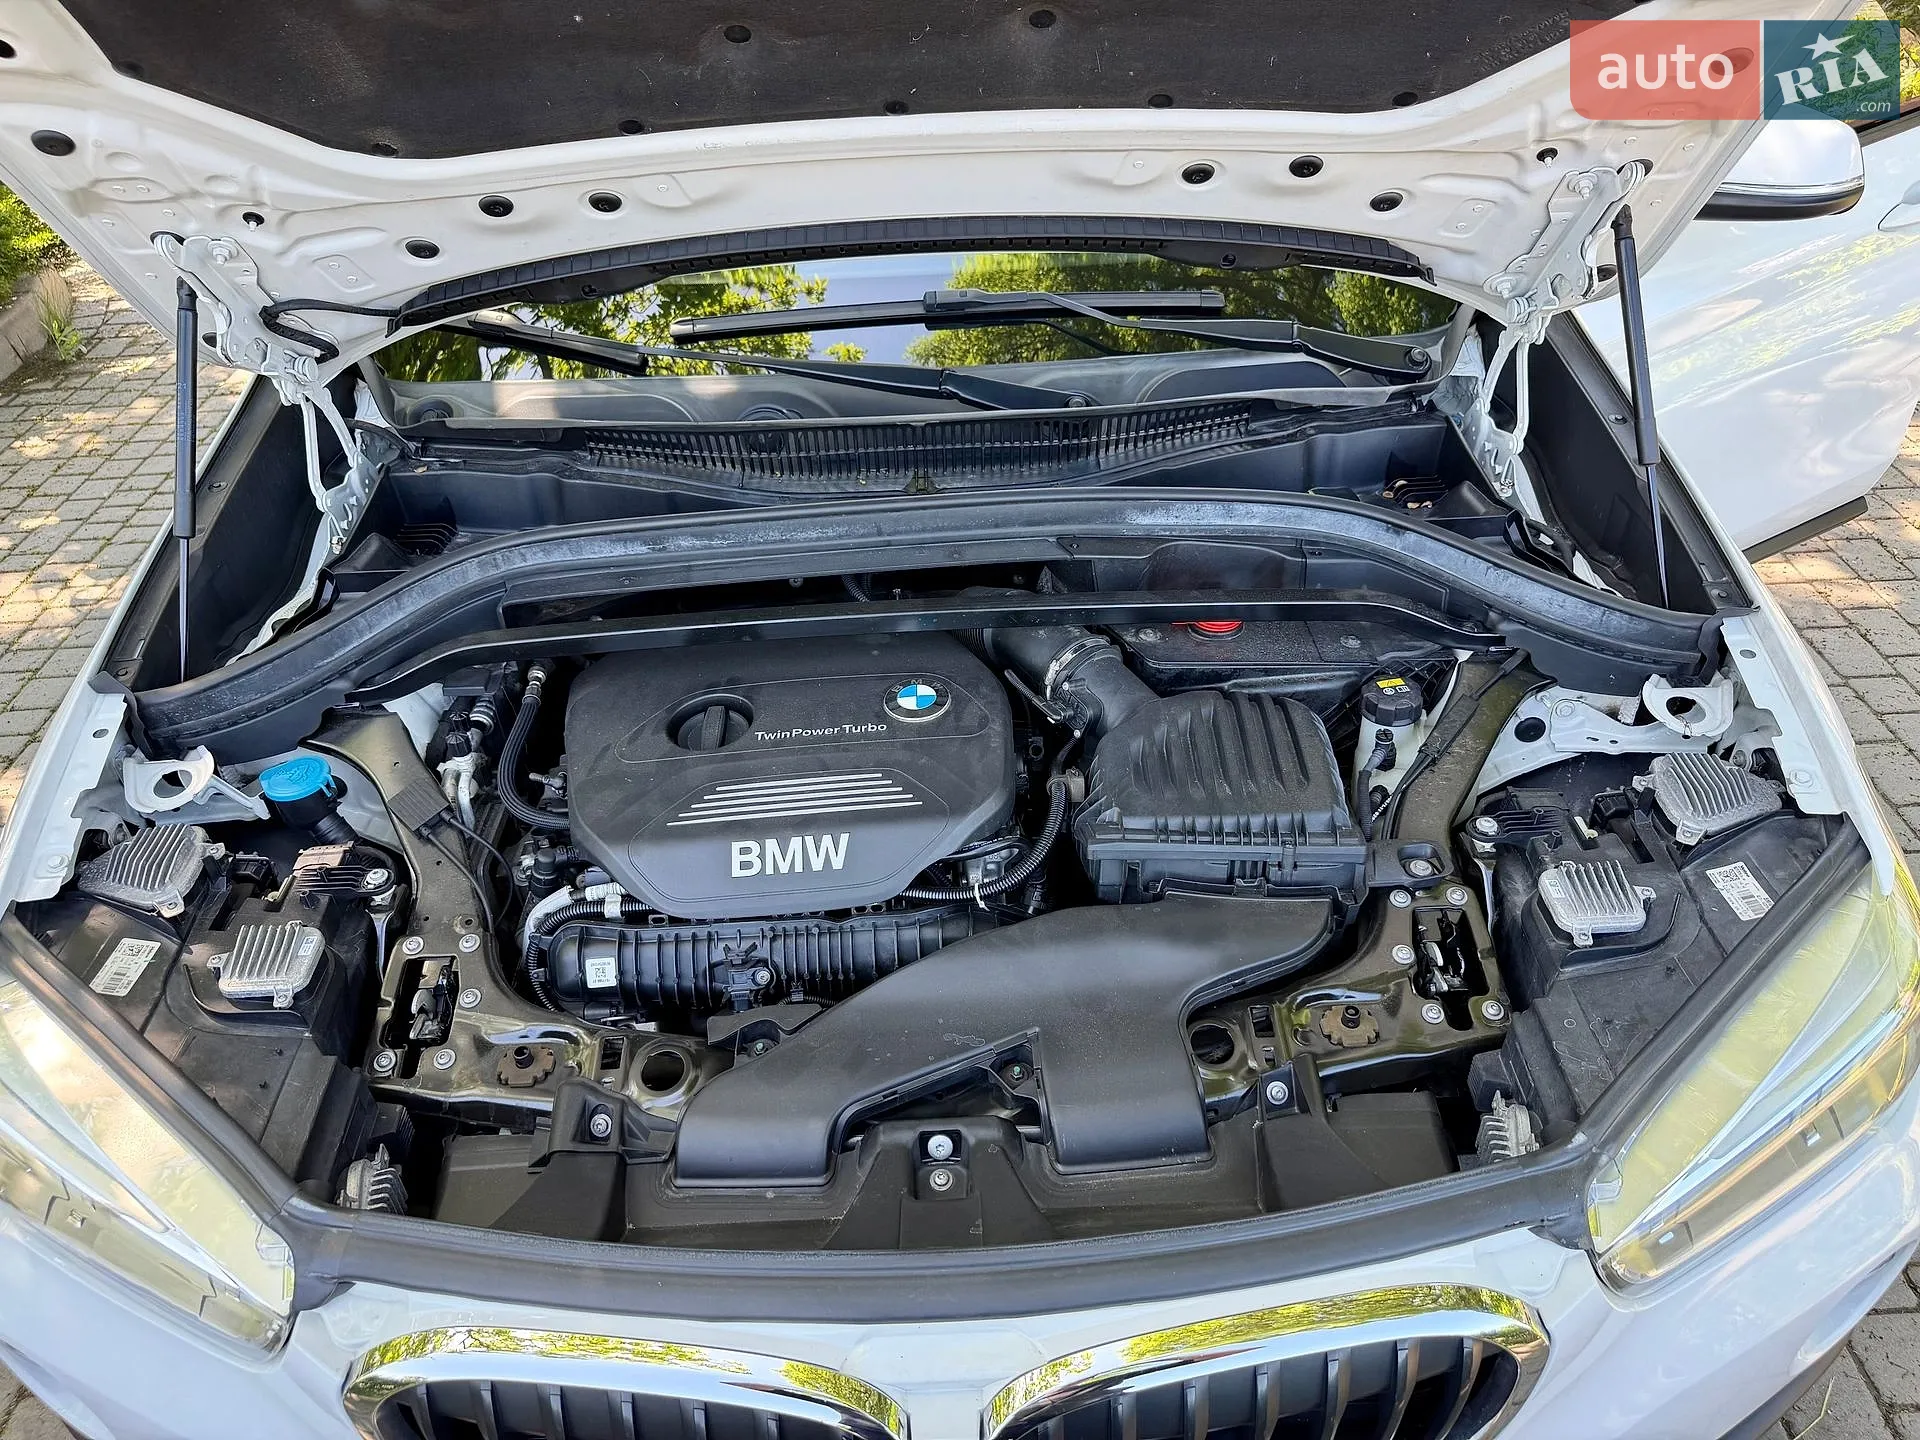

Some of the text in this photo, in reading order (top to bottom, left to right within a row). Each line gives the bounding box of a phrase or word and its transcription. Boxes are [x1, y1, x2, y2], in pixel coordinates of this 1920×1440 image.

[754, 722, 888, 741] TwinPower Turbo
[730, 832, 850, 878] BMW
